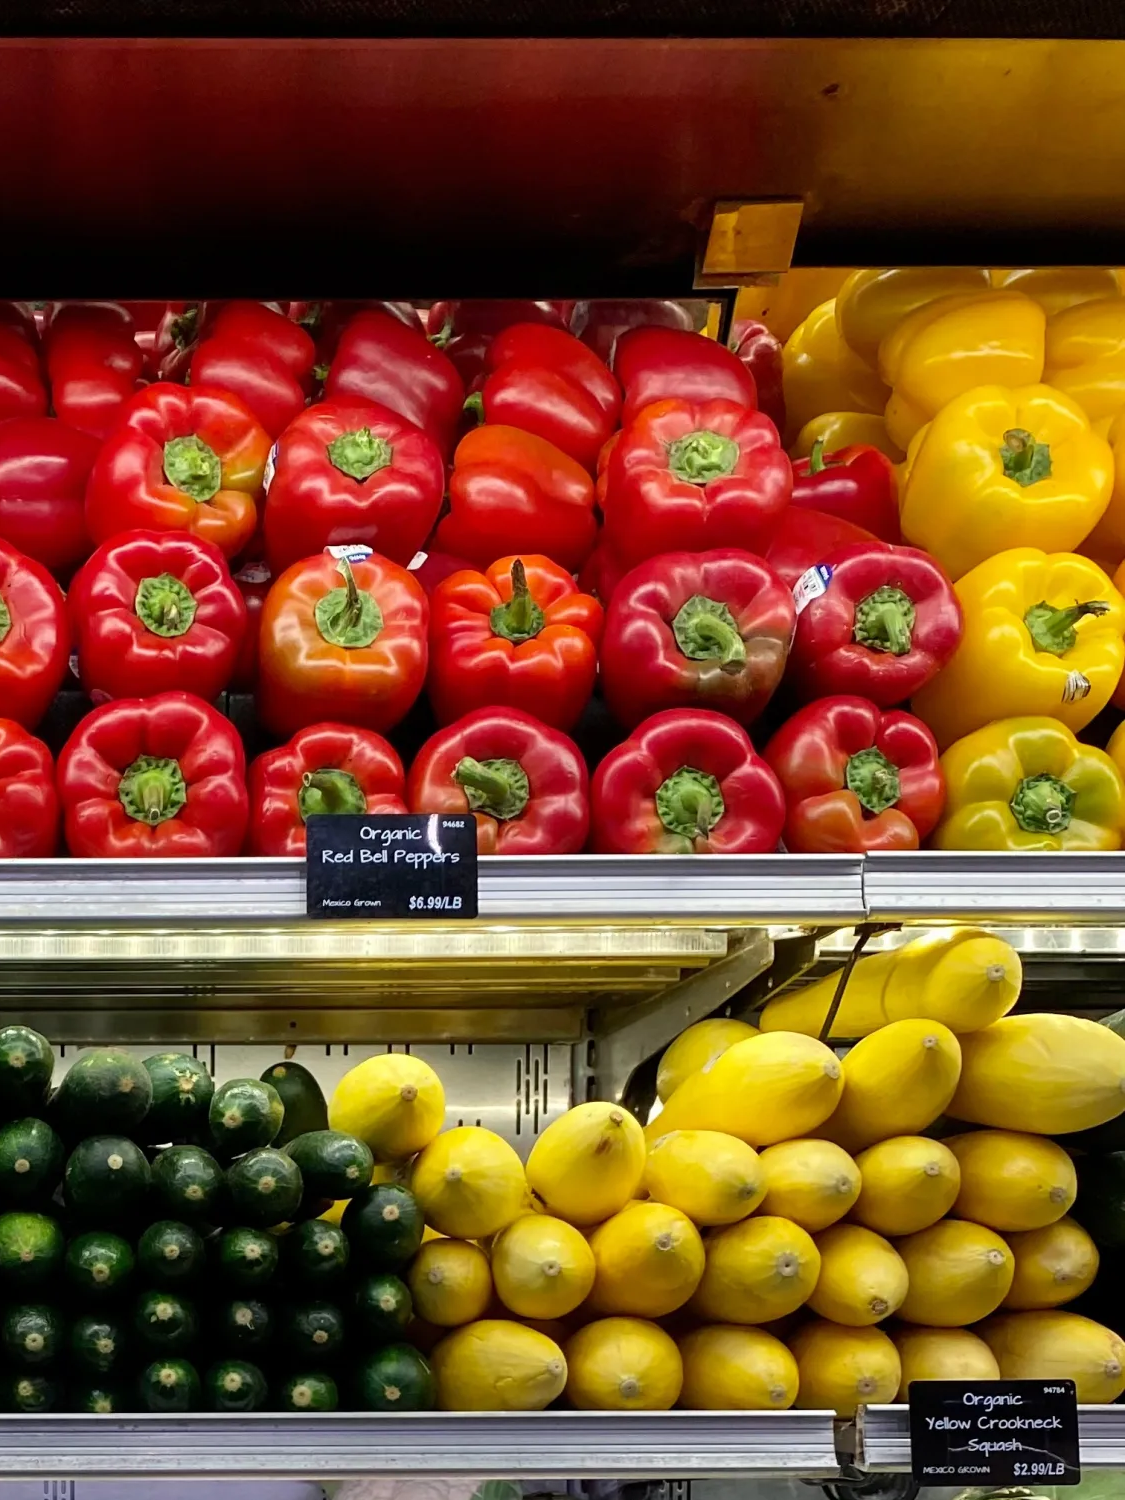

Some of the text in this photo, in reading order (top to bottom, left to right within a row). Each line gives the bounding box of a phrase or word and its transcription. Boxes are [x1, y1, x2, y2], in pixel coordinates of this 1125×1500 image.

[360, 827, 422, 846] Organic
[322, 850, 460, 869] Red Bell Peppers
[323, 899, 381, 907] Mexico Grown
[409, 896, 462, 910] $6.99/LB
[963, 1393, 1023, 1412] Organic
[925, 1416, 1063, 1430] Yellow Crookneck
[968, 1438, 1023, 1457] Squash
[923, 1466, 955, 1474] MEXICO
[1014, 1463, 1065, 1476] $2.99/LB
